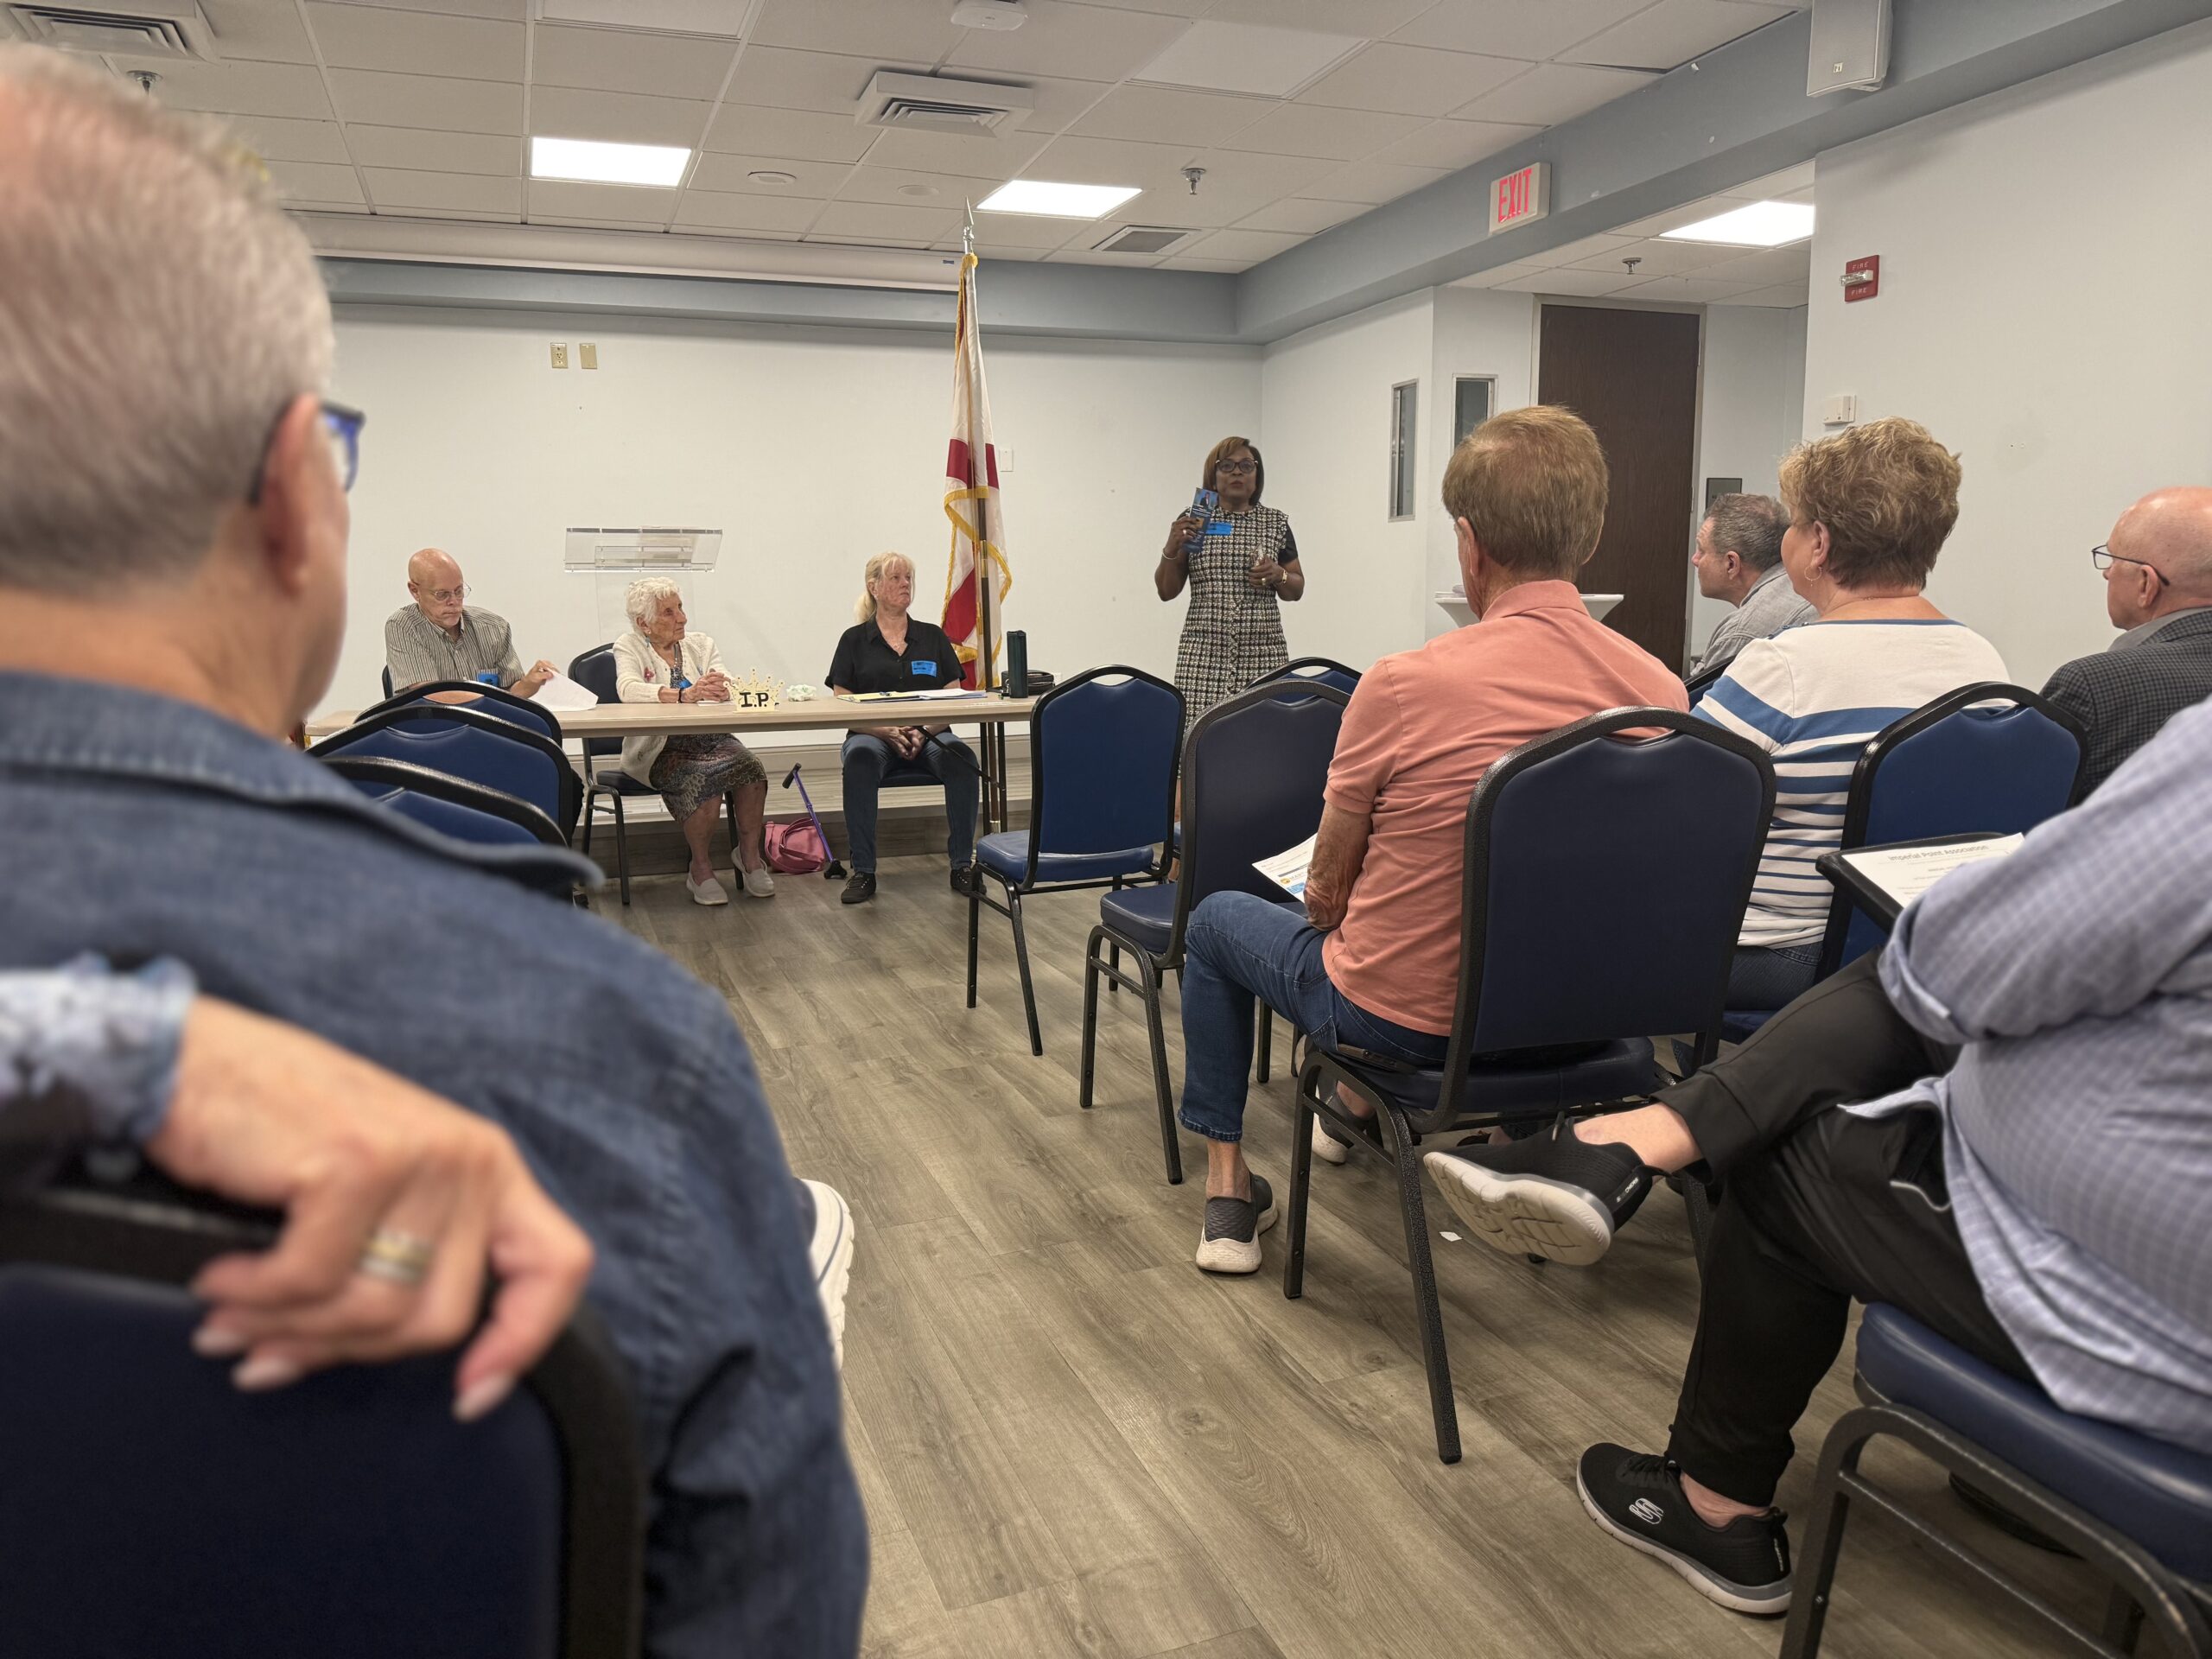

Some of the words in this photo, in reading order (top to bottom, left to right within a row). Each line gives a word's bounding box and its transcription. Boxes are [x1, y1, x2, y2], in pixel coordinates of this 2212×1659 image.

[1498, 168, 1532, 222] EXIT
[1852, 262, 1869, 270] FIRE
[1851, 287, 1867, 296] FIRE
[739, 691, 767, 708] I.P.
[1888, 851, 1922, 861] Imperial
[1922, 849, 1943, 858] Point
[1943, 845, 1989, 855] Association
